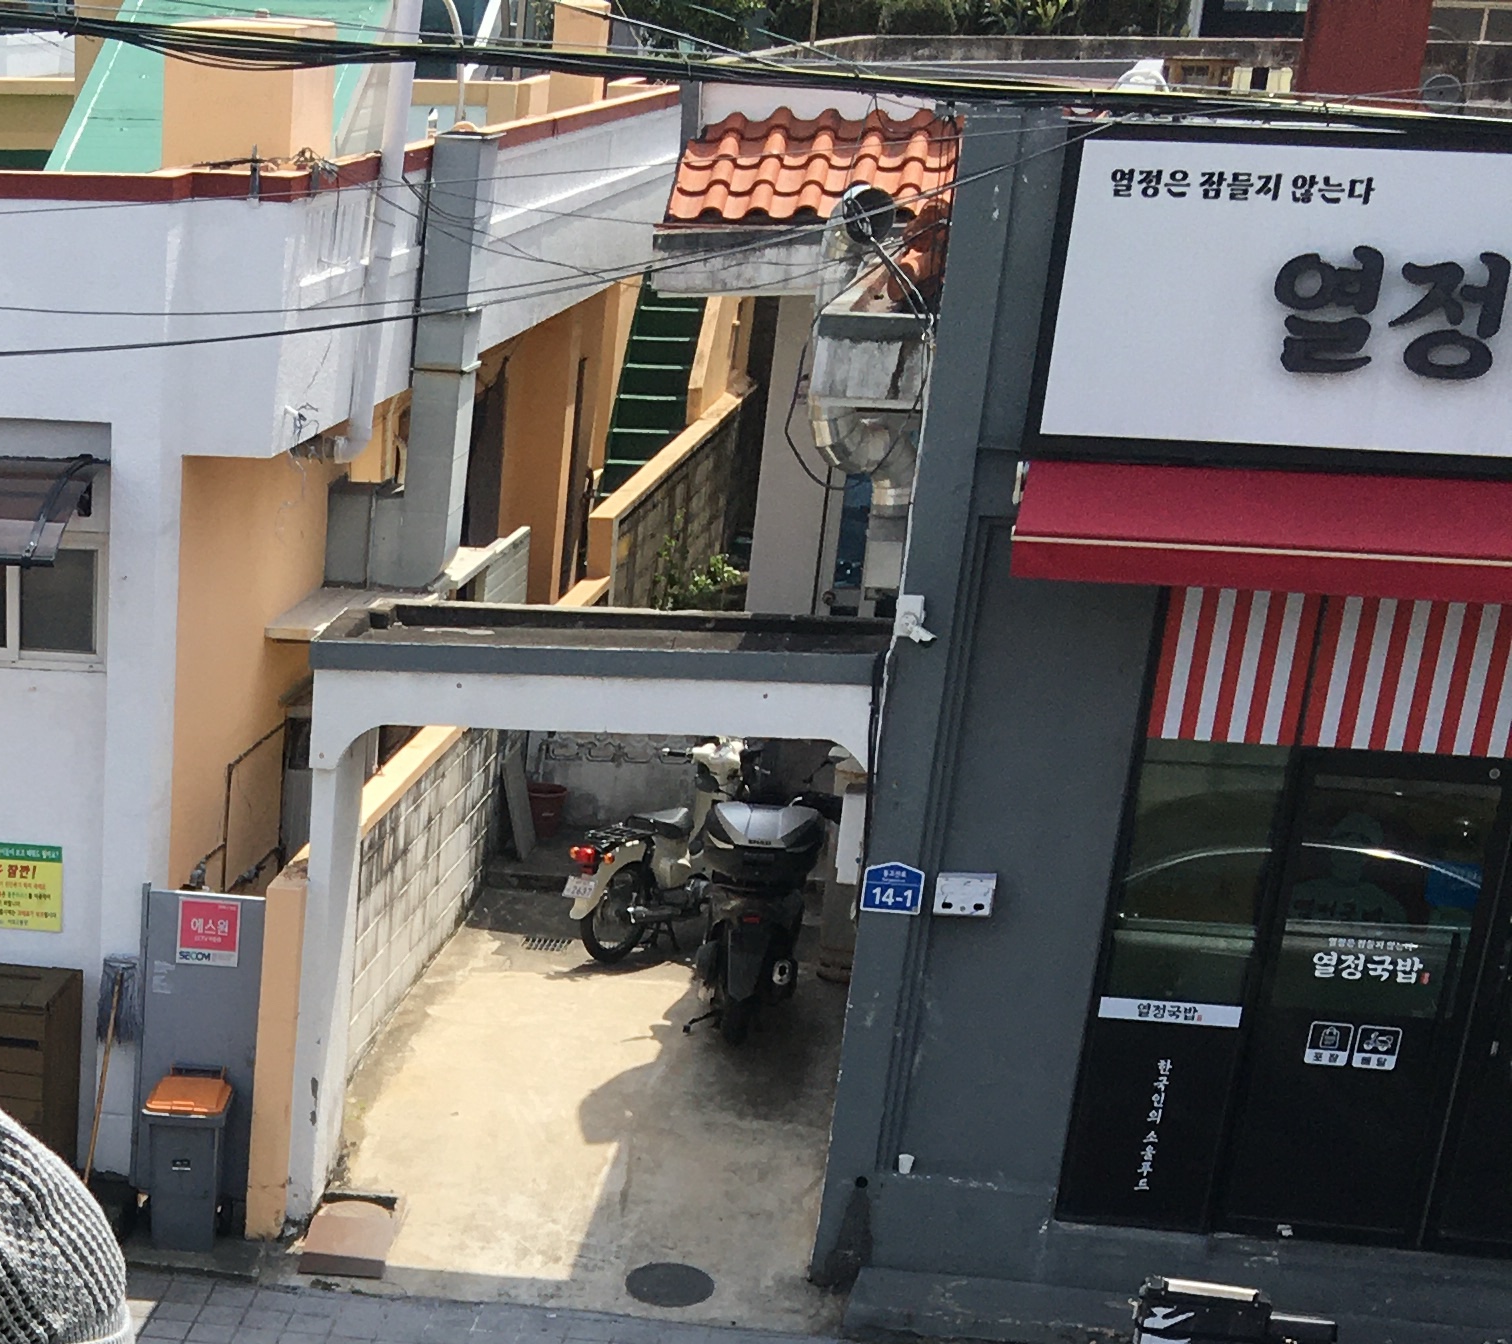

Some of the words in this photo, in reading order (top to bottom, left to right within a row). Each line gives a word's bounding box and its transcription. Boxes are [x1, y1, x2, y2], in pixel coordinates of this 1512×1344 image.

[1110, 168, 1191, 198] 열정은
[1199, 171, 1283, 201] 잠들지
[1291, 174, 1376, 205] 않는다
[1274, 245, 1511, 380] 열정
[7, 864, 37, 879] 잠깐!
[872, 887, 913, 907] 14-1
[191, 918, 229, 936] 에스원
[179, 951, 211, 961] SECOM
[1313, 951, 1423, 984] 열정국밥
[1137, 1002, 1198, 1021] 열정국밥
[1146, 1059, 1173, 1124] 한국인의
[1133, 1130, 1159, 1190] 소울푸드
